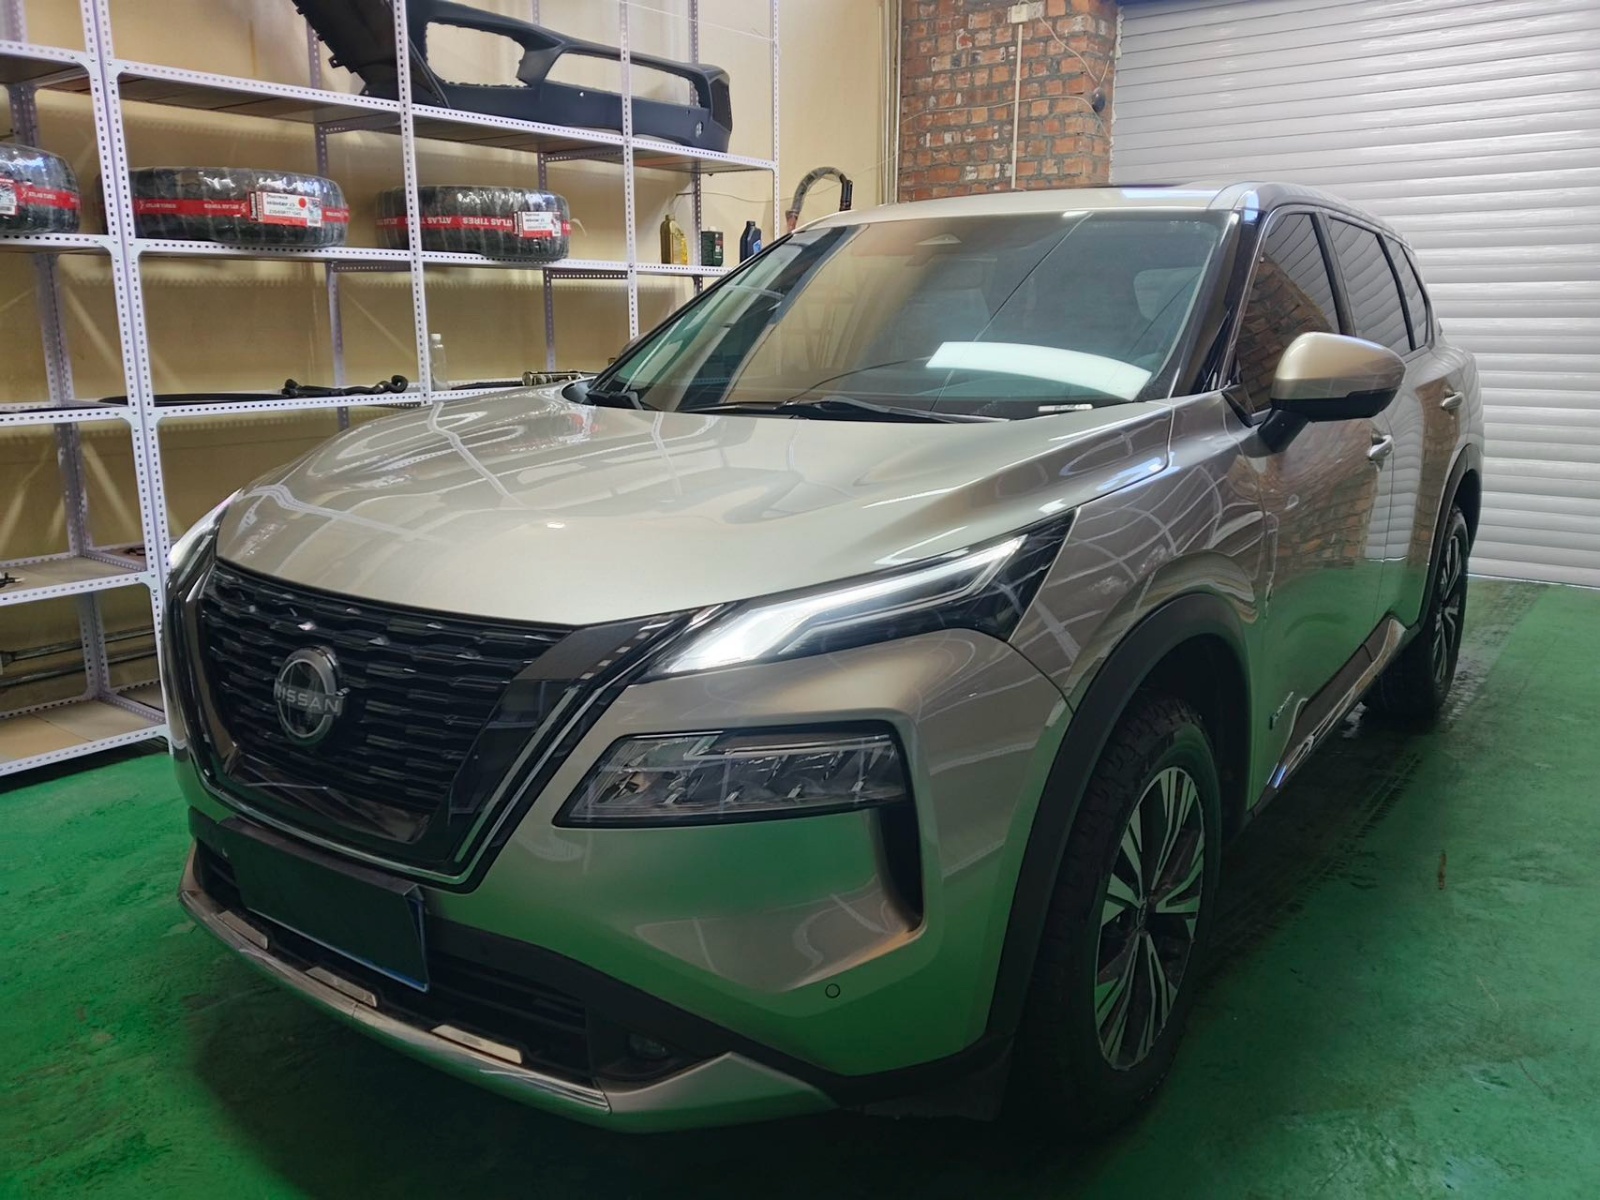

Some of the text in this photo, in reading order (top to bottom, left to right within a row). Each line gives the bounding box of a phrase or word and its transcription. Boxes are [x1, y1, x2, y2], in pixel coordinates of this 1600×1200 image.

[427, 216, 452, 224] ATLAS
[462, 216, 489, 225] TIRES
[275, 683, 340, 713] NISSAN
